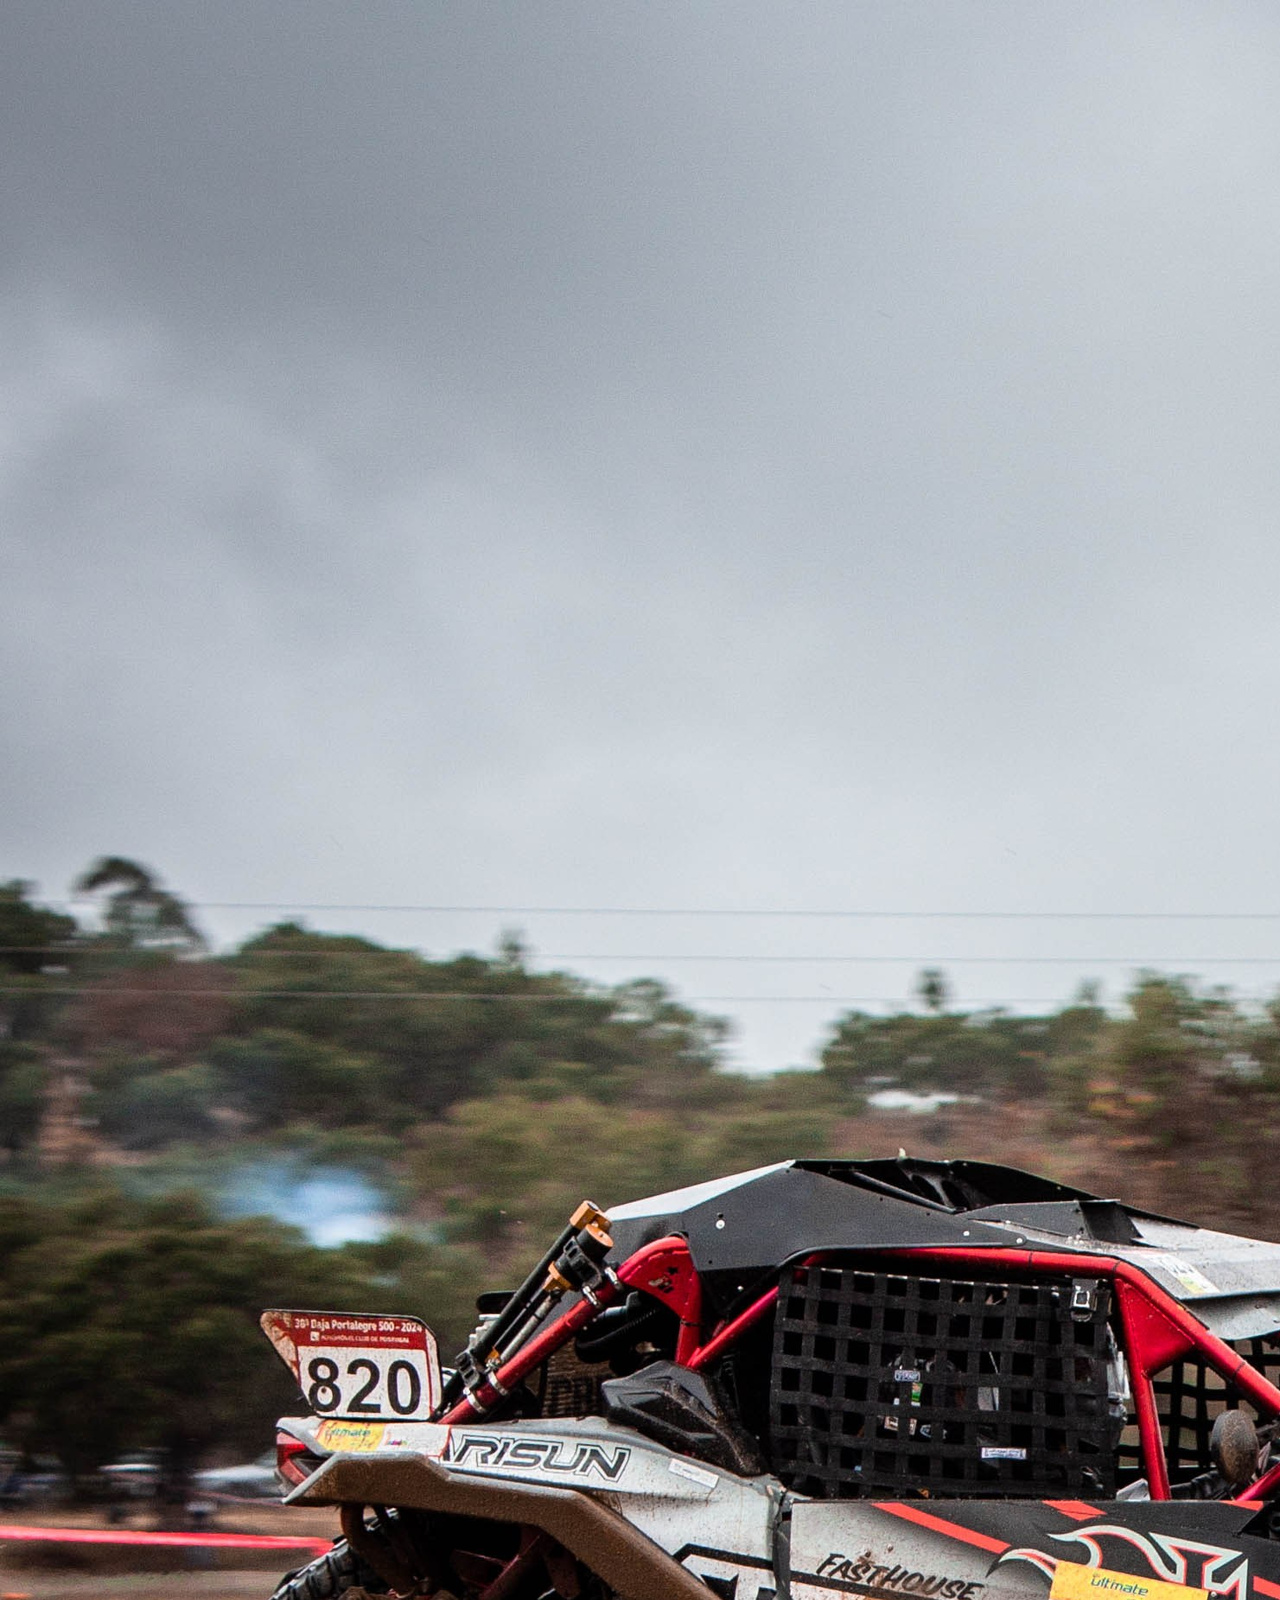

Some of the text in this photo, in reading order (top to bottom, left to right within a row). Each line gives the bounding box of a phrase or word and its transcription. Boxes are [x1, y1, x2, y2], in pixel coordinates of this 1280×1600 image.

[331, 1319, 377, 1334] Portalegre
[378, 1320, 395, 1332] 500
[401, 1321, 423, 1333] 2024
[308, 1357, 421, 1415] 820
[816, 1552, 984, 1600] FASTHOUSE
[1091, 1576, 1149, 1597] ultimate
